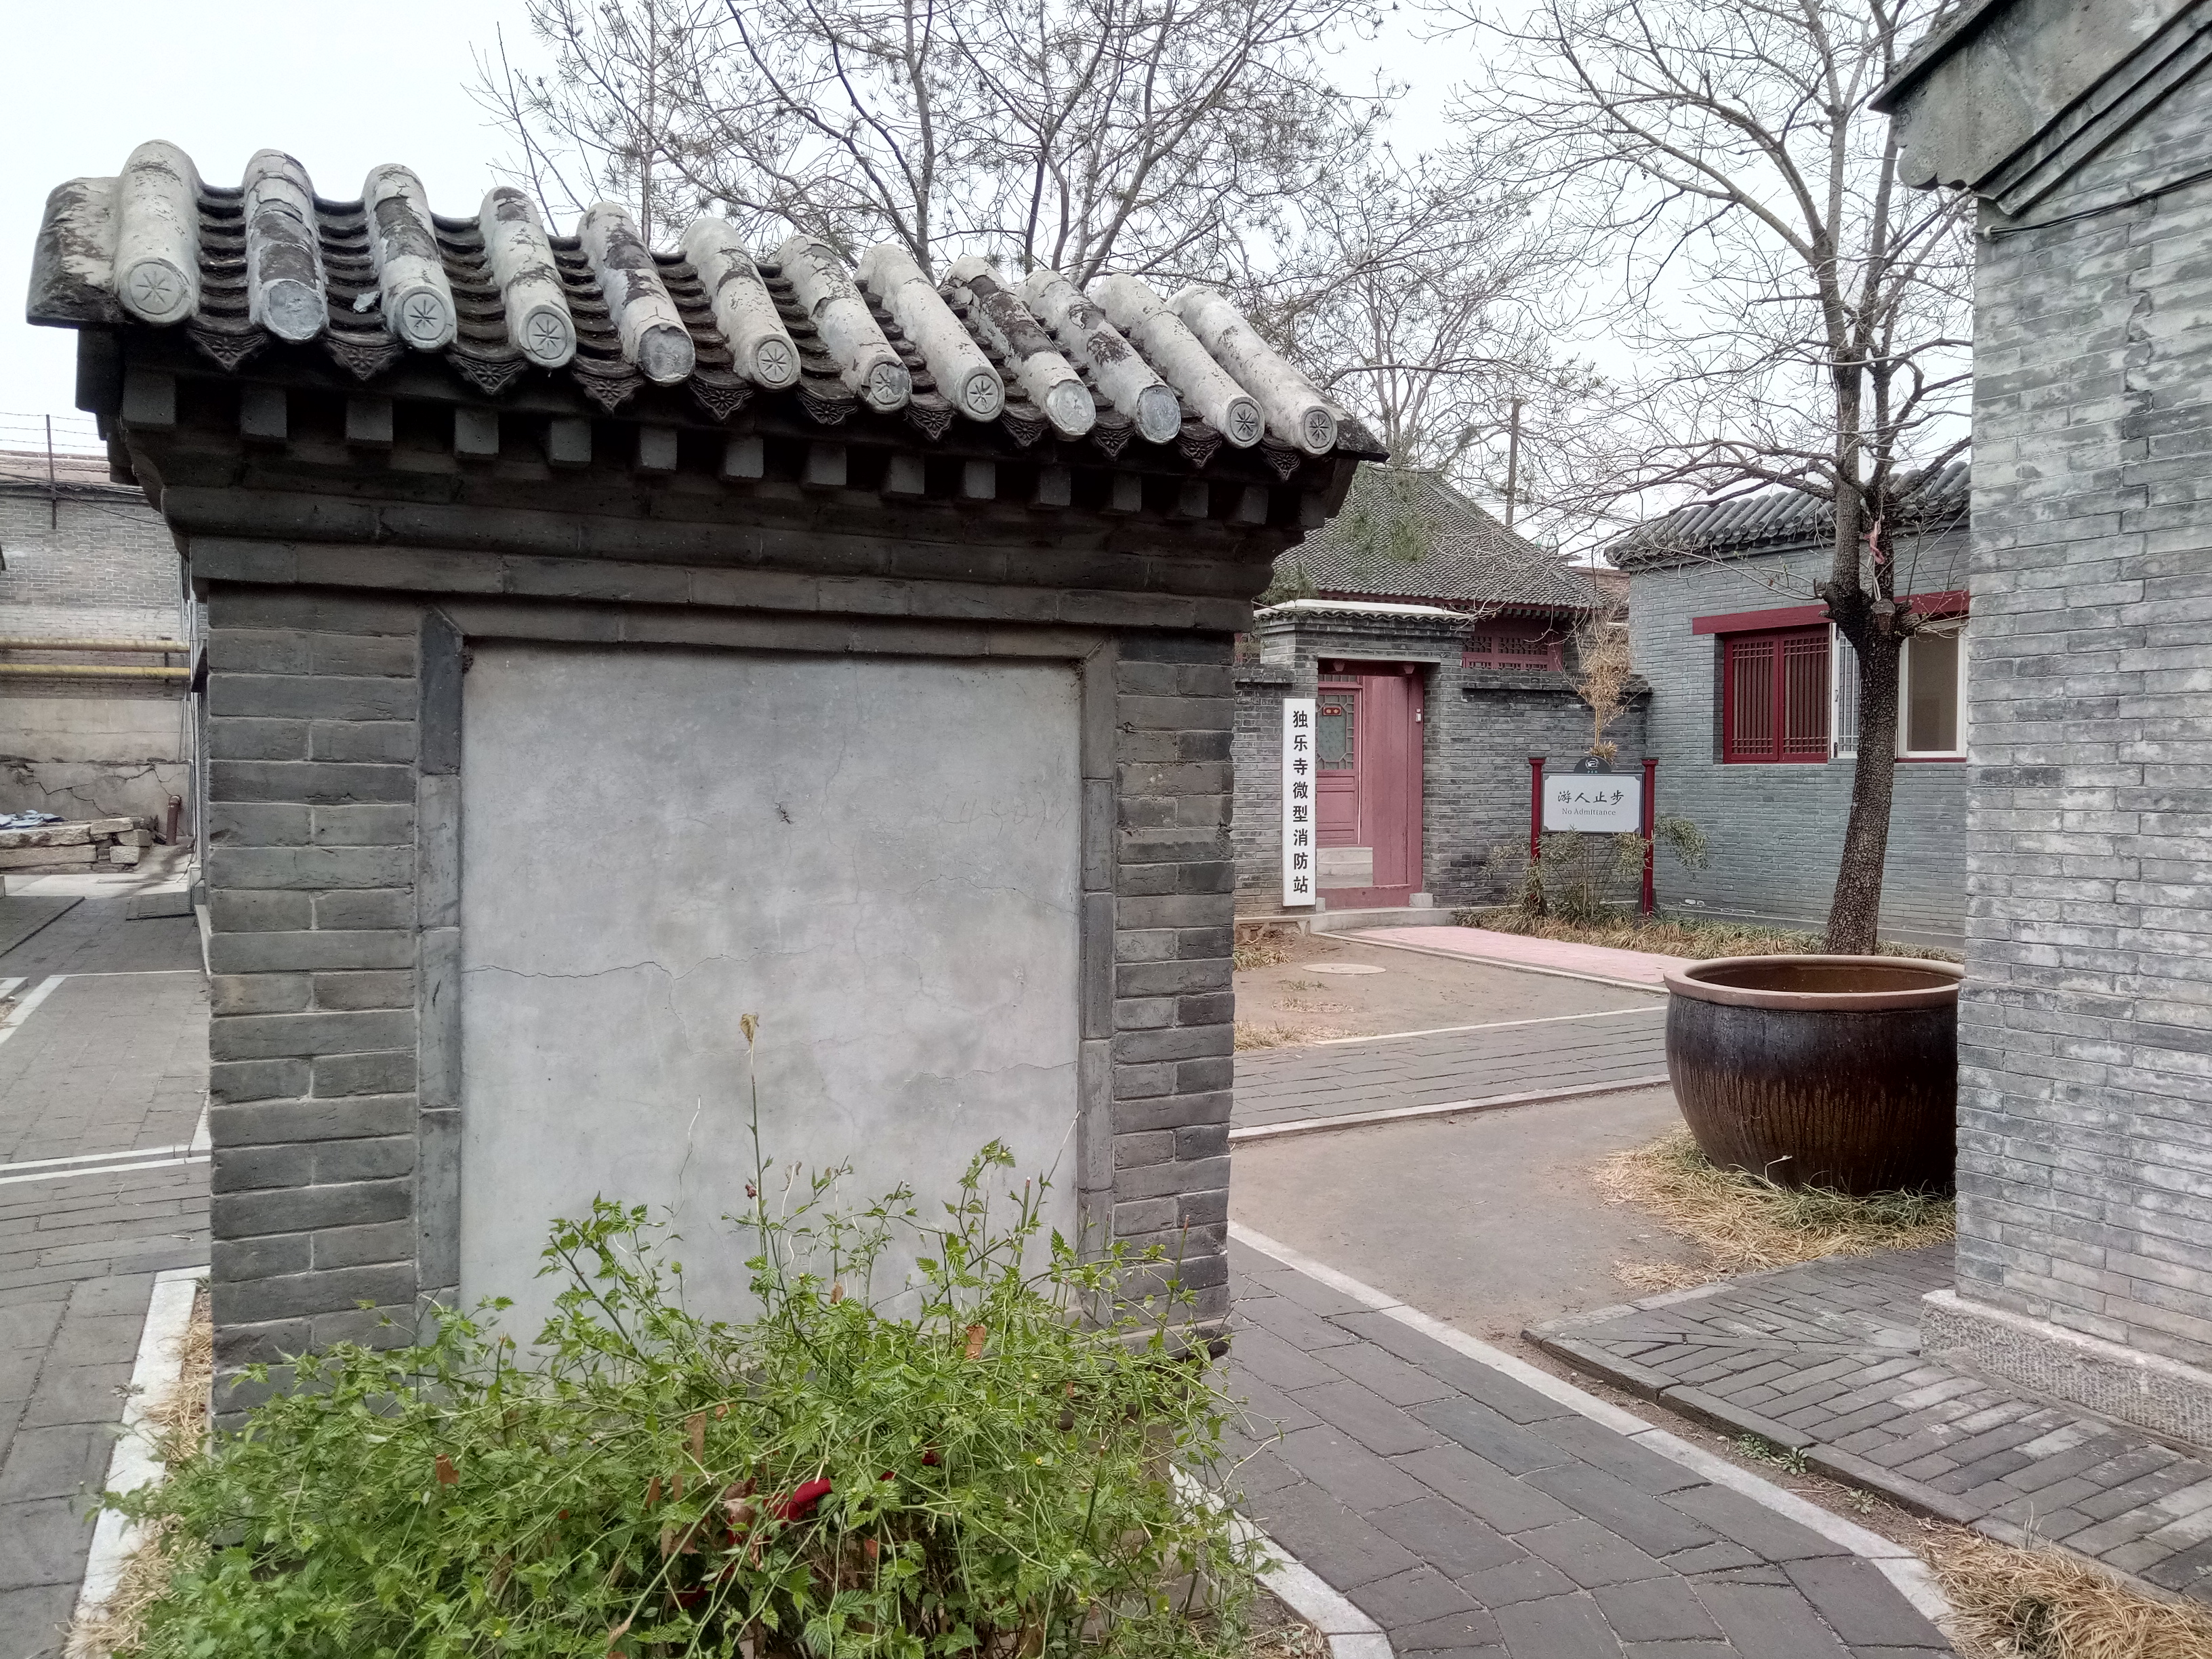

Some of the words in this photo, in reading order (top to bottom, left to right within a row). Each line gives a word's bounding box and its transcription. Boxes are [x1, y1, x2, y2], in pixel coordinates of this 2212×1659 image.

[1292, 710, 1309, 894] 独乐寺微型消防站
[1557, 790, 1624, 806] 游人止步
[1562, 807, 1572, 815] No
